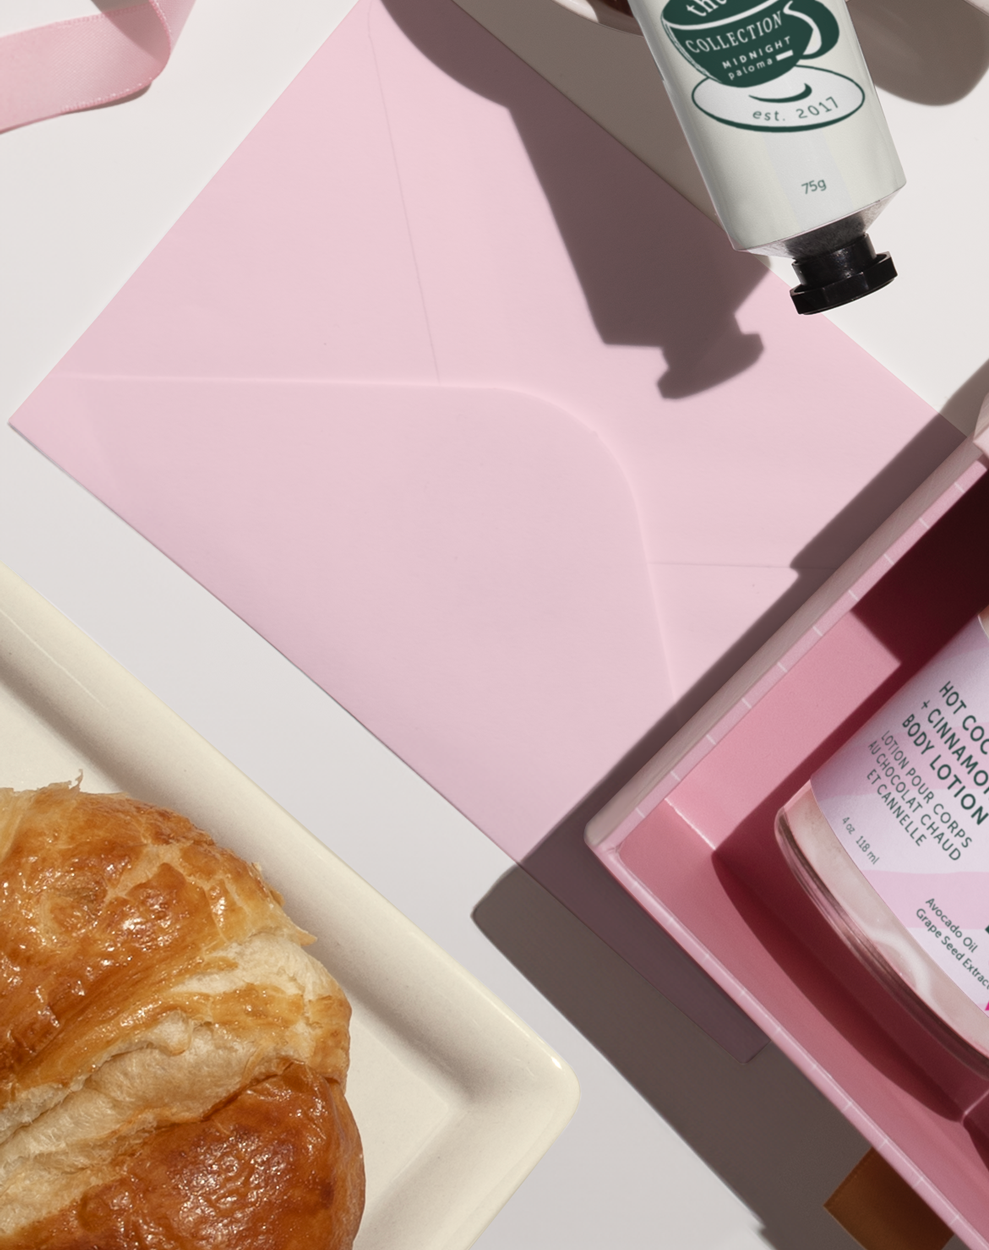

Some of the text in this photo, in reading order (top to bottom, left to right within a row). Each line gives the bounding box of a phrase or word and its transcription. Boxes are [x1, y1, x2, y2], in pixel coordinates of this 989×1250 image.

[685, 10, 784, 53] COLLECTION
[722, 36, 791, 69] MIDNIGHT
[728, 57, 773, 80] paloma
[752, 96, 839, 122] est. 2017
[801, 178, 827, 195] 75g
[921, 700, 930, 710] +
[939, 680, 967, 715] HOT
[881, 730, 972, 848] LOTION POUR CORPS
[902, 714, 989, 825] BODY LOTION
[867, 769, 927, 847] ET CANNELLE
[868, 740, 962, 861] AU CHOCOLAT CHAUD
[842, 816, 850, 824] 4
[855, 835, 870, 852] 118
[867, 851, 880, 865] ml
[915, 908, 942, 939] Grape
[941, 936, 963, 961] Seed
[925, 897, 979, 954] Avocado Oil
